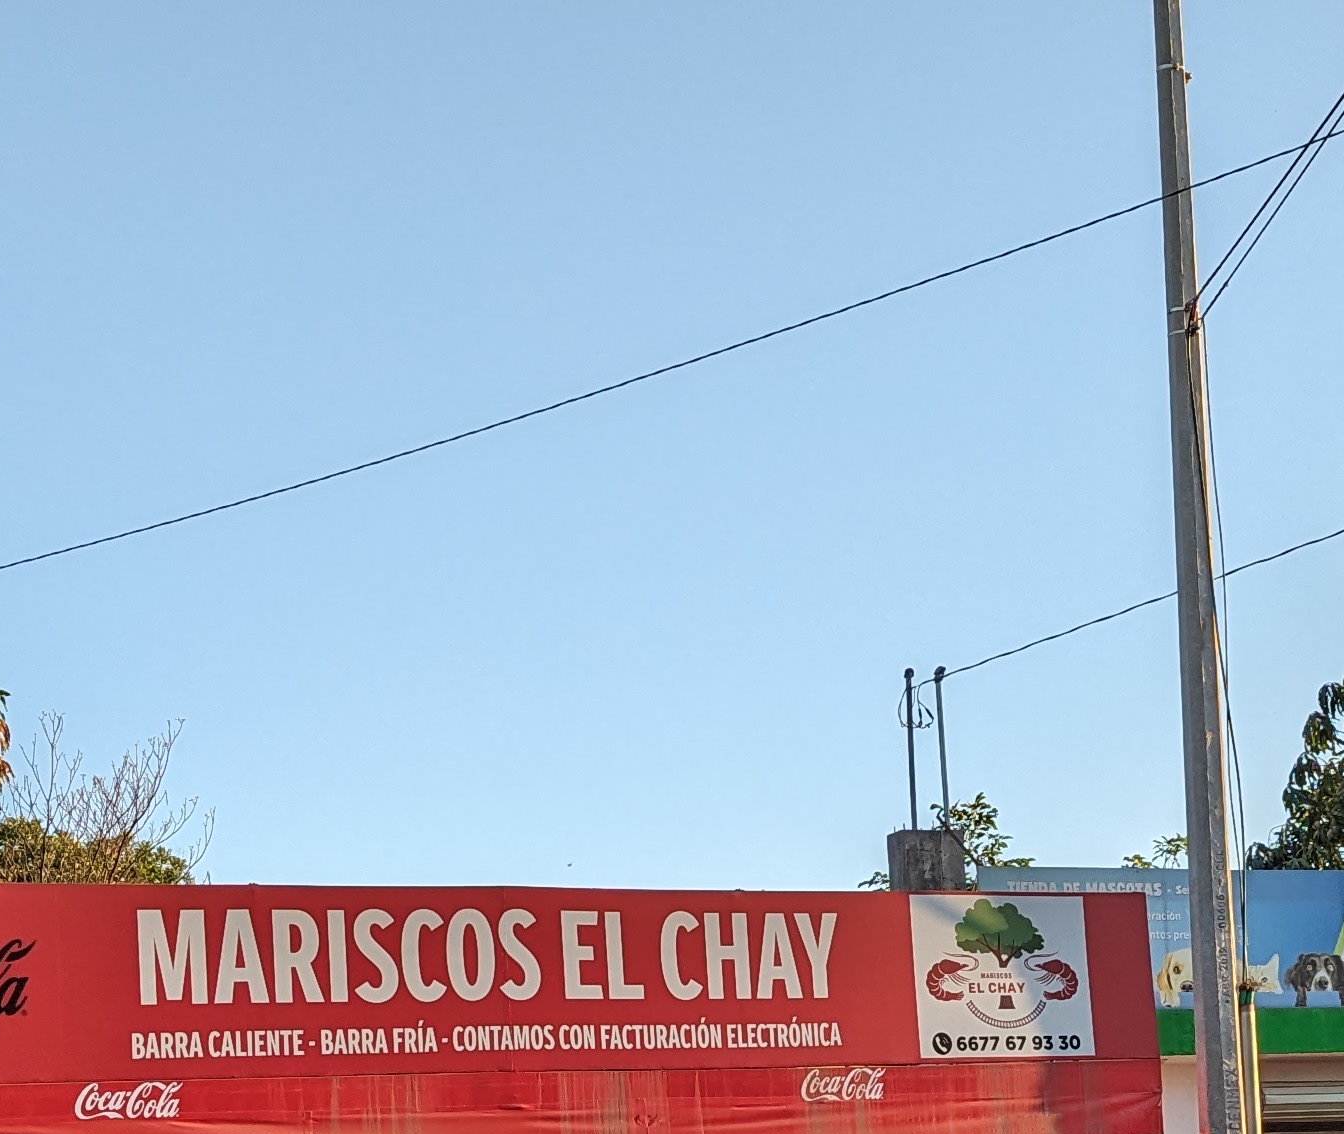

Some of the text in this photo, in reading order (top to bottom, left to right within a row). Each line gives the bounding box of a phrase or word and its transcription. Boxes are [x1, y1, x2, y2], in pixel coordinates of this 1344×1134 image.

[1086, 882, 1162, 897] MASCOTAS
[136, 907, 837, 1005] MARISCOS EL CHAY
[968, 982, 1026, 994] EL CHAY
[131, 1032, 204, 1060] BARRA
[208, 1029, 305, 1057] CALIENTE
[321, 1027, 388, 1055] BARRA
[393, 1020, 437, 1053] FRÍA
[452, 1024, 555, 1052] CONTAMOS
[559, 1024, 596, 1050] CON
[600, 1017, 723, 1050] FACTURACIÓN
[727, 1016, 843, 1049] ELECTRÓNICA
[956, 1035, 1081, 1051] 6677 67 93 30
[74, 1082, 184, 1120] Coca-Cola
[800, 1068, 887, 1102] Coca-Cola
